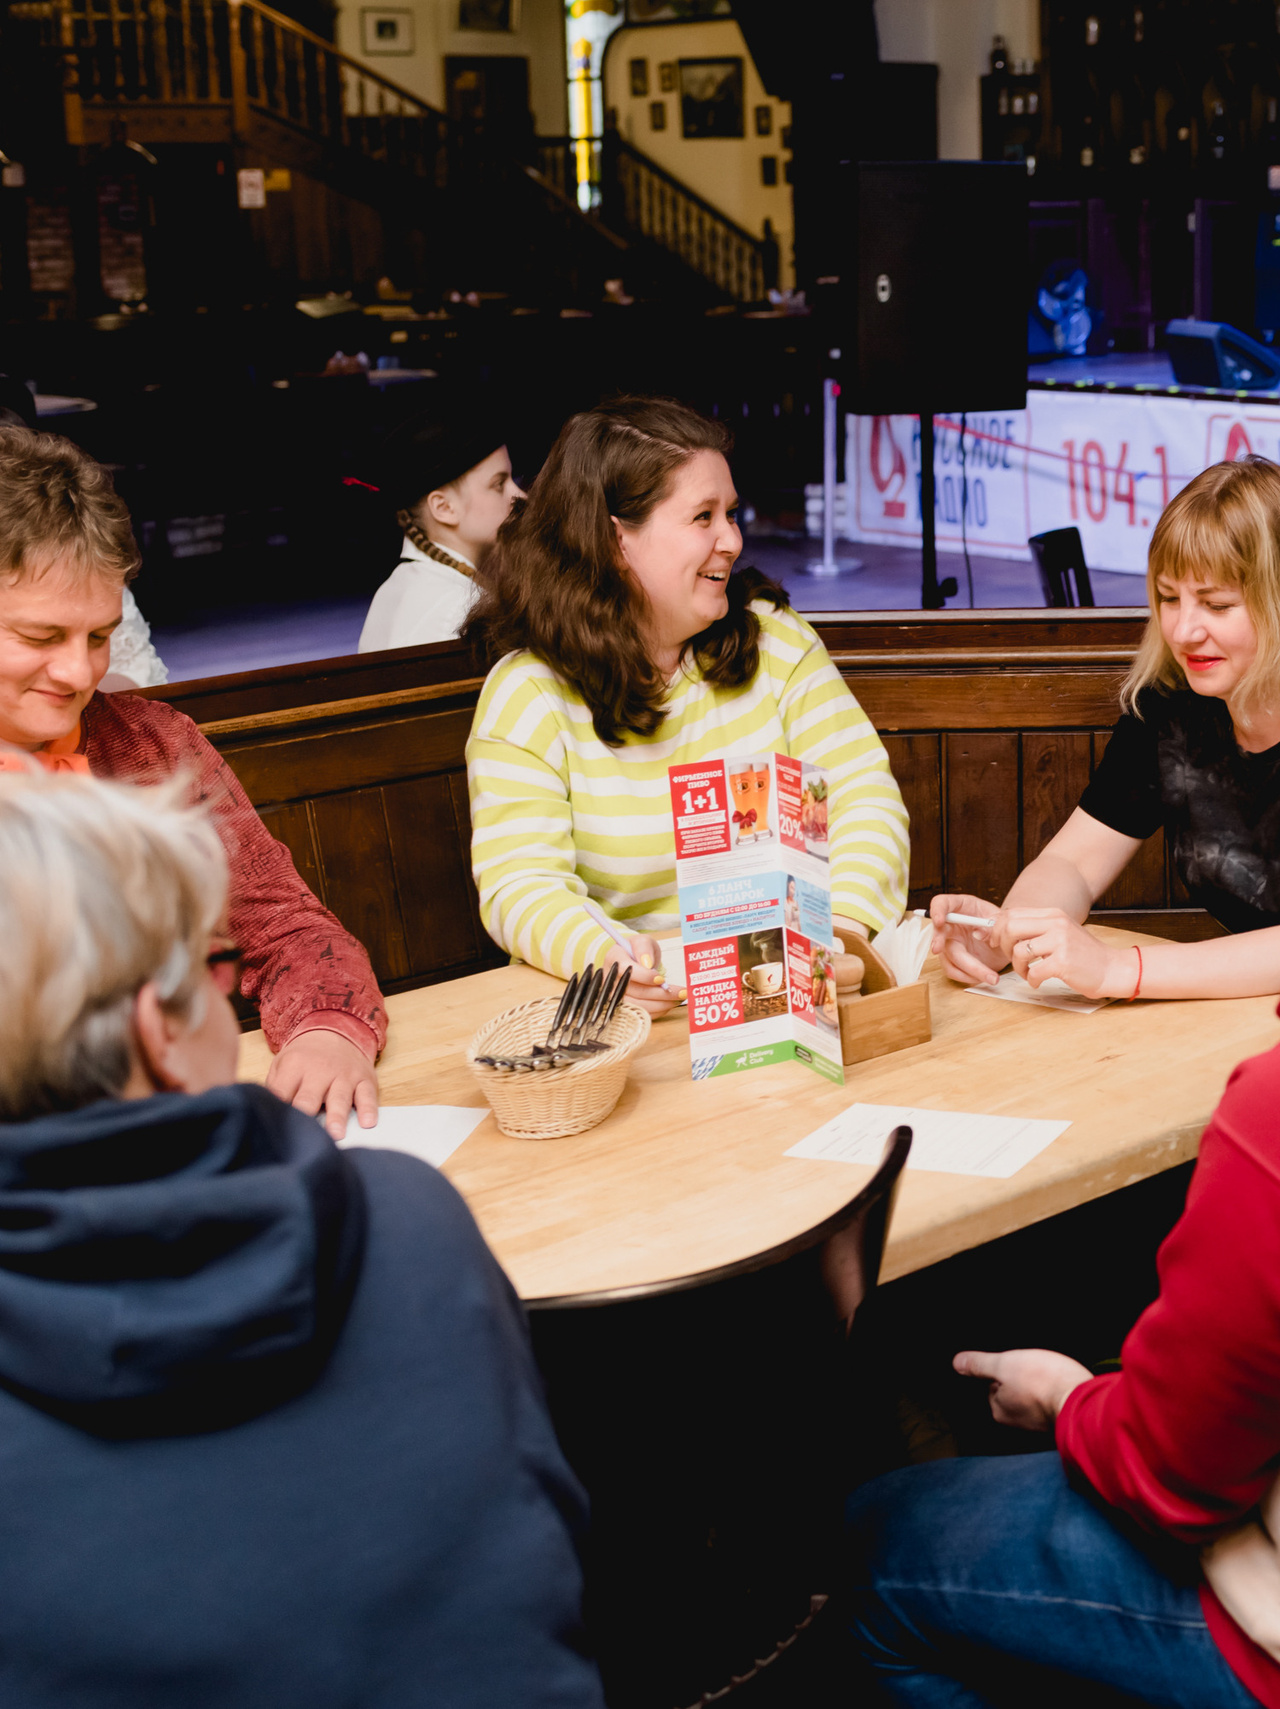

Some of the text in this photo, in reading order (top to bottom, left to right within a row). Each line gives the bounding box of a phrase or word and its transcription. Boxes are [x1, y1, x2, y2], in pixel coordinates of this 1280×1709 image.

[1063, 439, 1169, 527] 104.1
[672, 769, 723, 784] ФИРМЕННОЕ
[687, 779, 710, 790] ПИВО
[681, 787, 719, 814] 1+1
[779, 813, 804, 841] 20%
[717, 879, 752, 894] ЛАНЧ
[707, 888, 765, 908] ПОДАРОК
[688, 943, 735, 962] КАЖДЫЙ
[699, 957, 726, 971] ДЕНЬ
[692, 980, 737, 997] СКИДКА
[695, 990, 738, 1007] НА КОФЕ
[790, 985, 814, 1014] 20%
[694, 1000, 739, 1026] 50%
[749, 1049, 774, 1059] Delivery
[749, 1056, 764, 1065] Club
